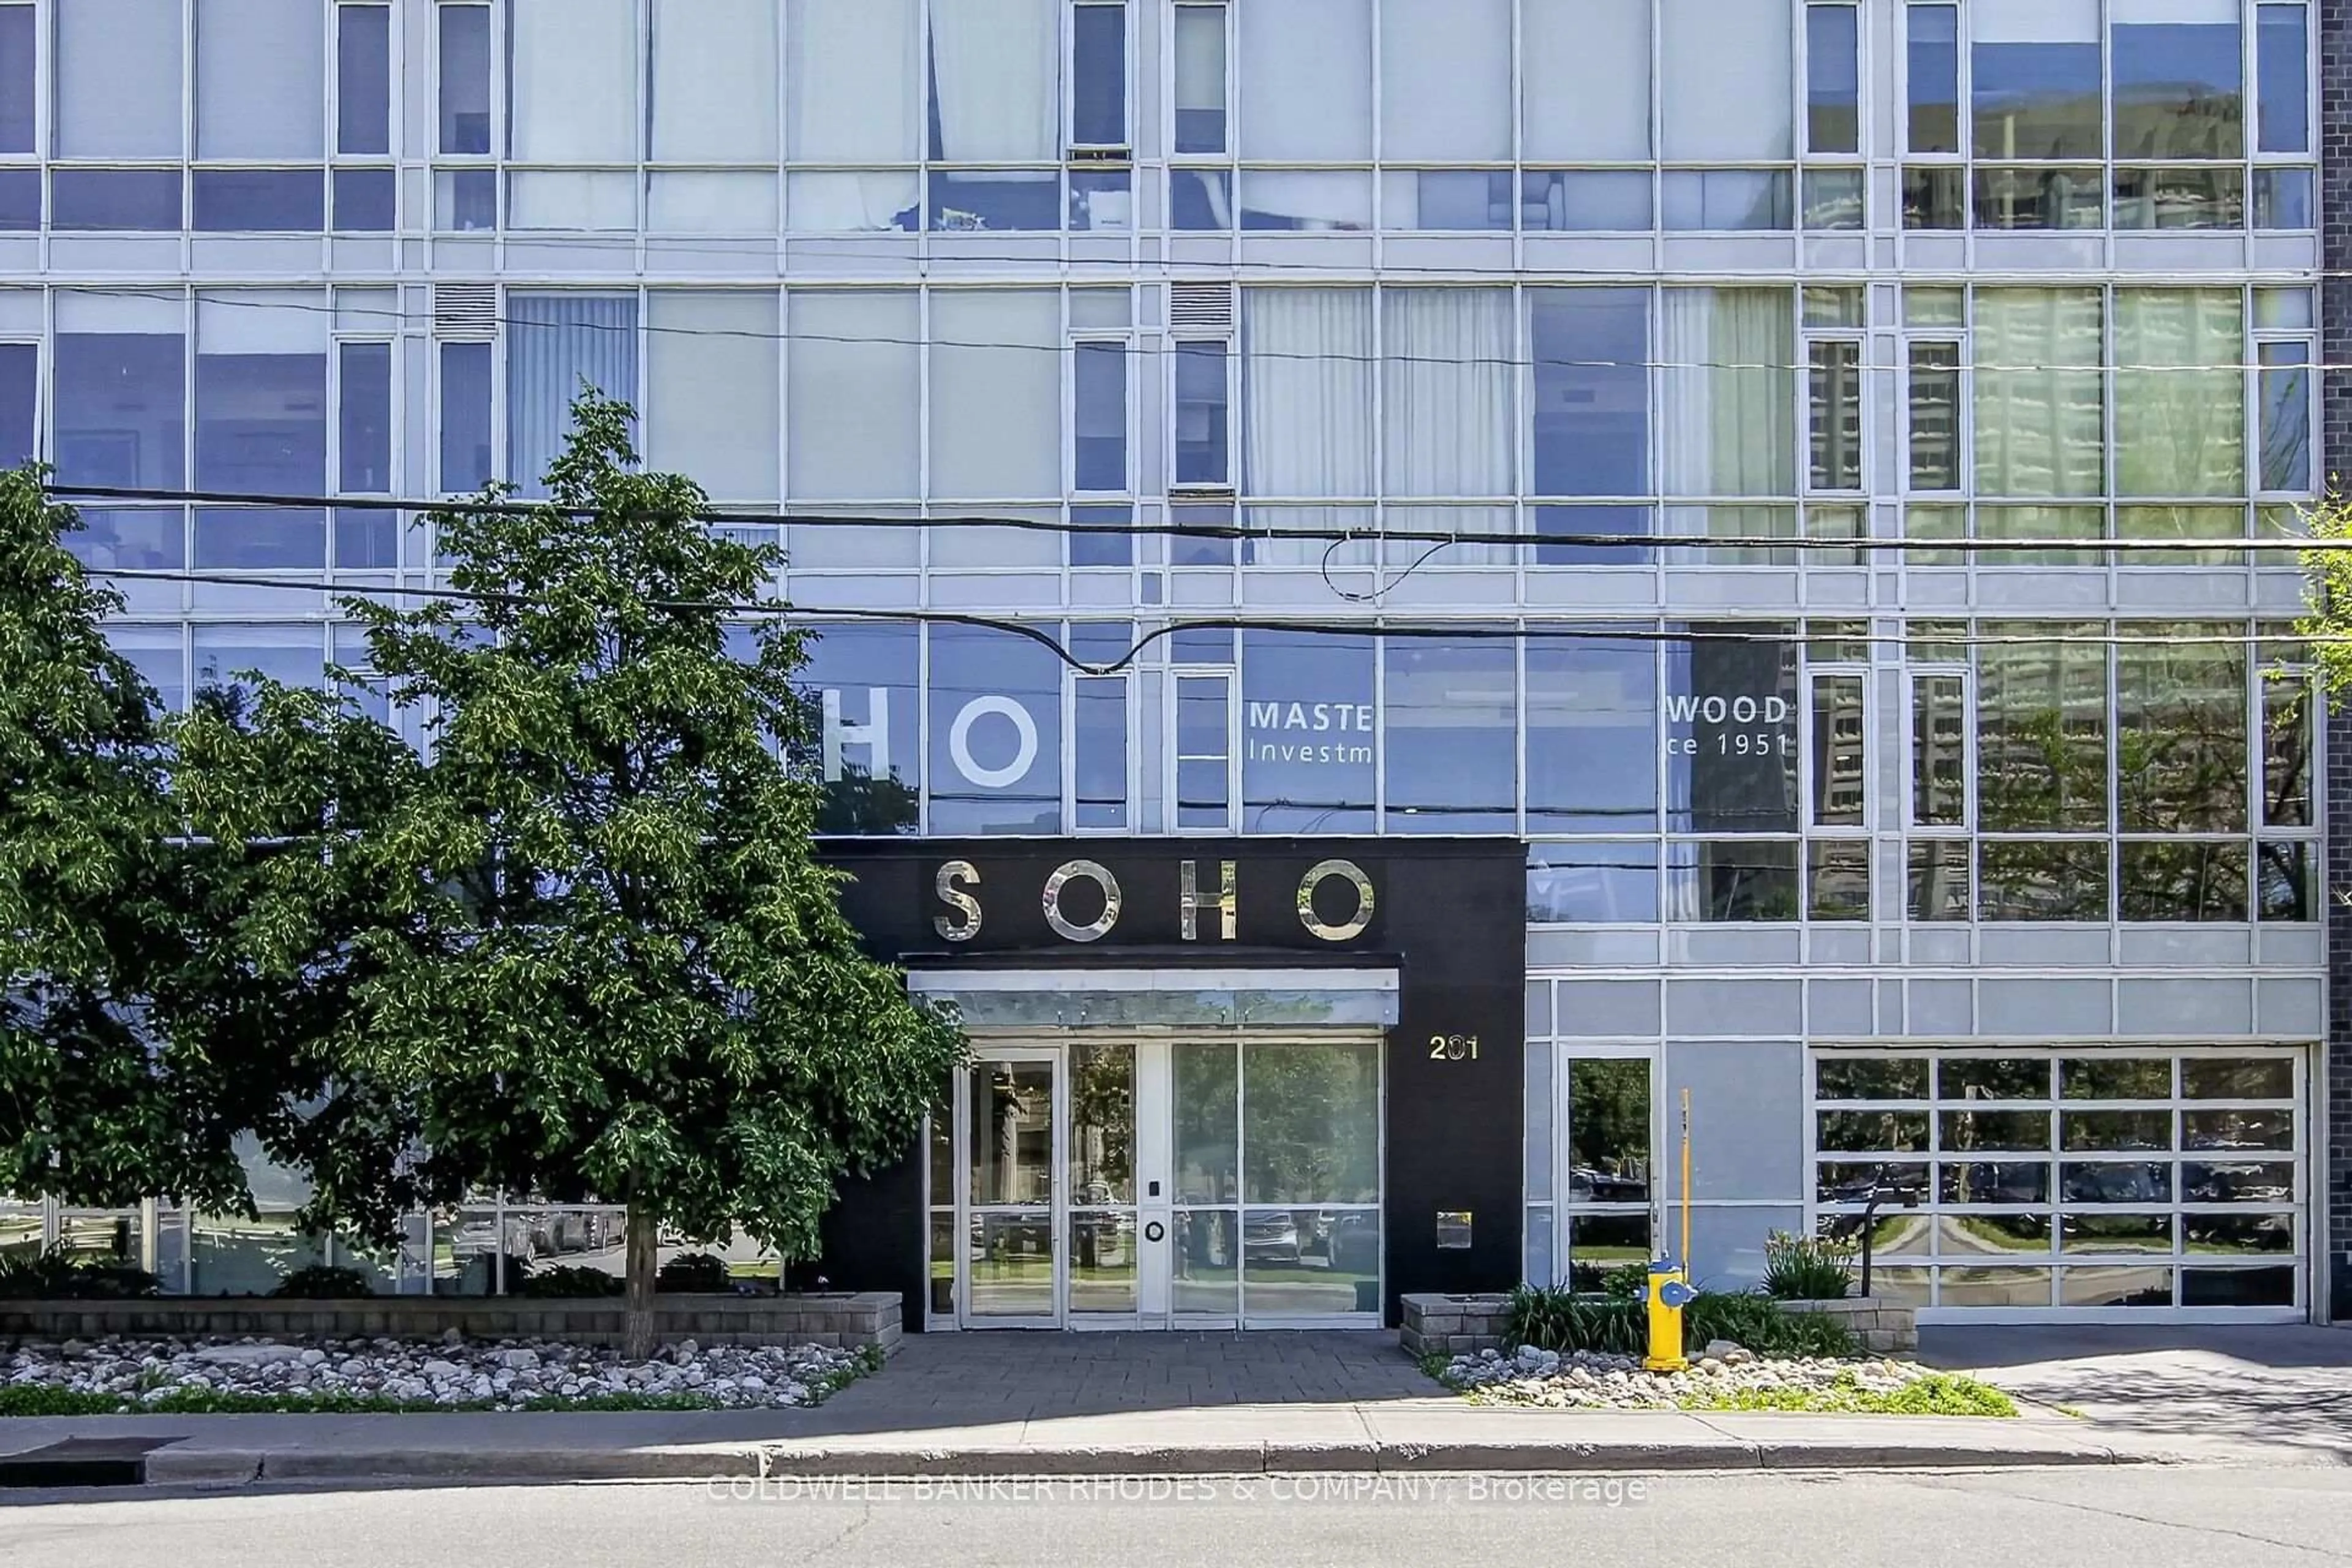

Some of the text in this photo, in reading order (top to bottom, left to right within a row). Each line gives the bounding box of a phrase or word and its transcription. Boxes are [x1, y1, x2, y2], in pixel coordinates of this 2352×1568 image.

[1250, 702, 1372, 731] MASTE
[1667, 695, 1786, 723] WOOD
[1250, 737, 1371, 763] Investm
[1717, 733, 1786, 755] 1951
[934, 859, 1376, 942] SOHO
[1430, 1035, 1479, 1060] 201
